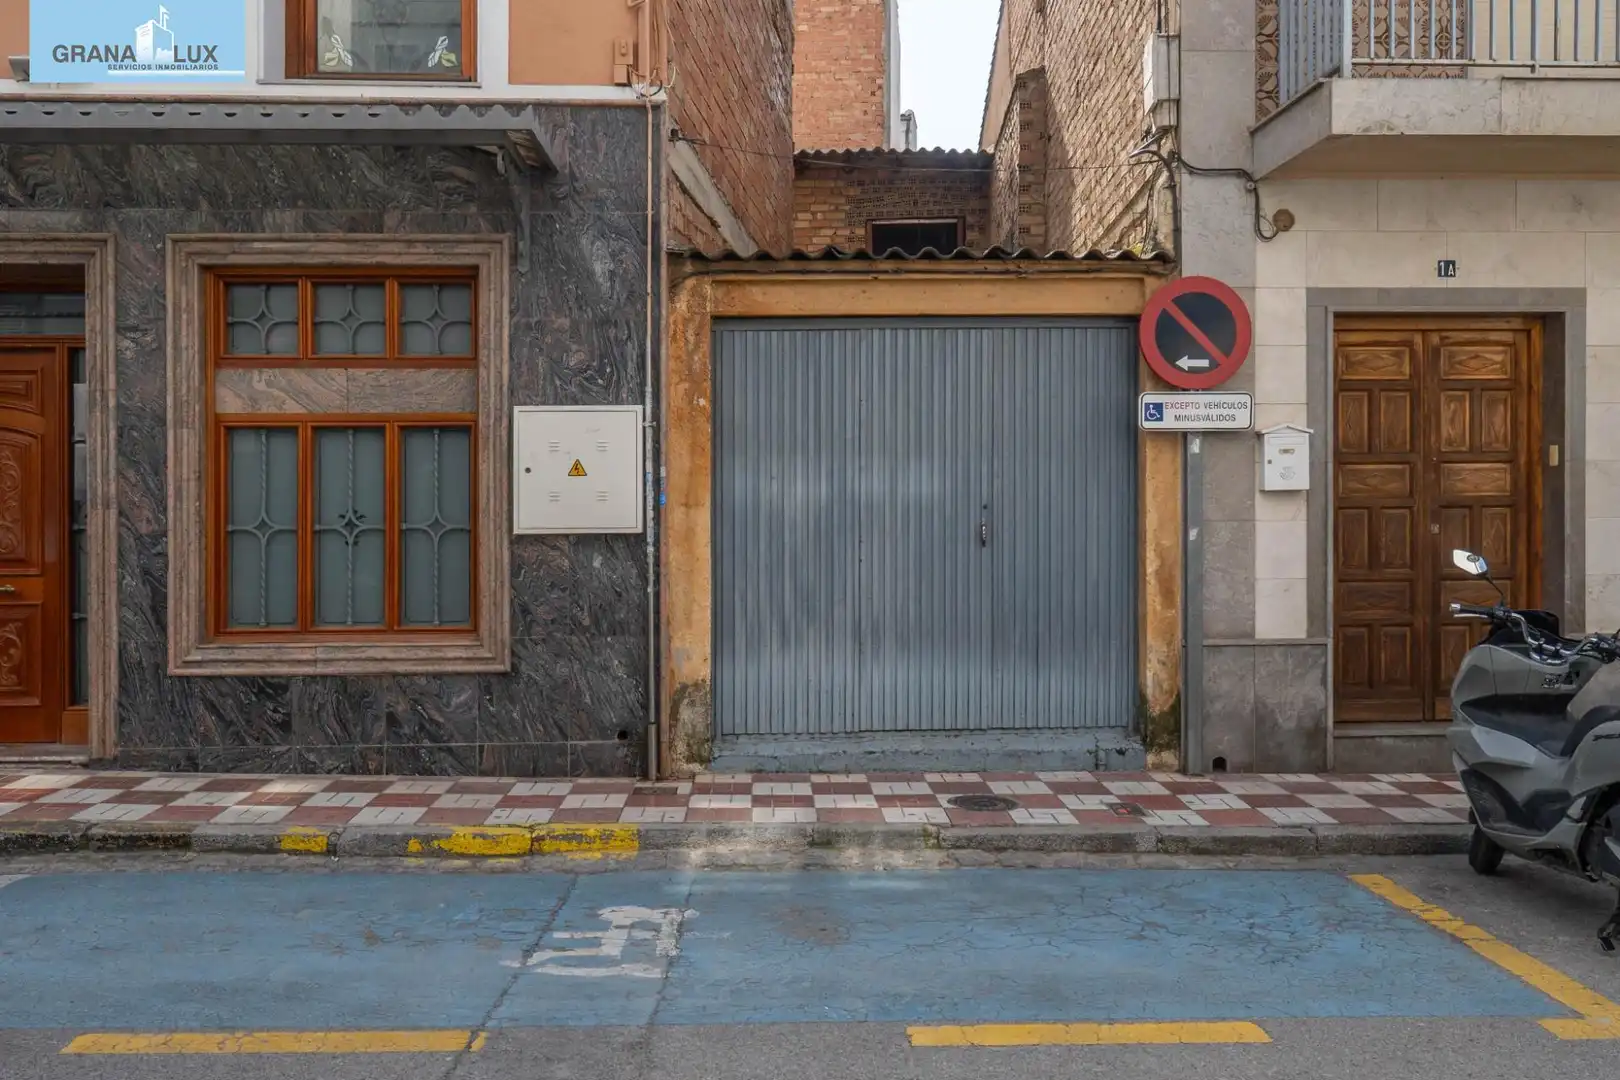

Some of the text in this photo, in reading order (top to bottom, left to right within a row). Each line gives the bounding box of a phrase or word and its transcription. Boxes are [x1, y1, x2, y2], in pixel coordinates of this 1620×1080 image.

[1164, 400, 1248, 410] EXCEPTO VEHÍCULOS
[1174, 412, 1237, 422] MINUSVÁLIDOS
